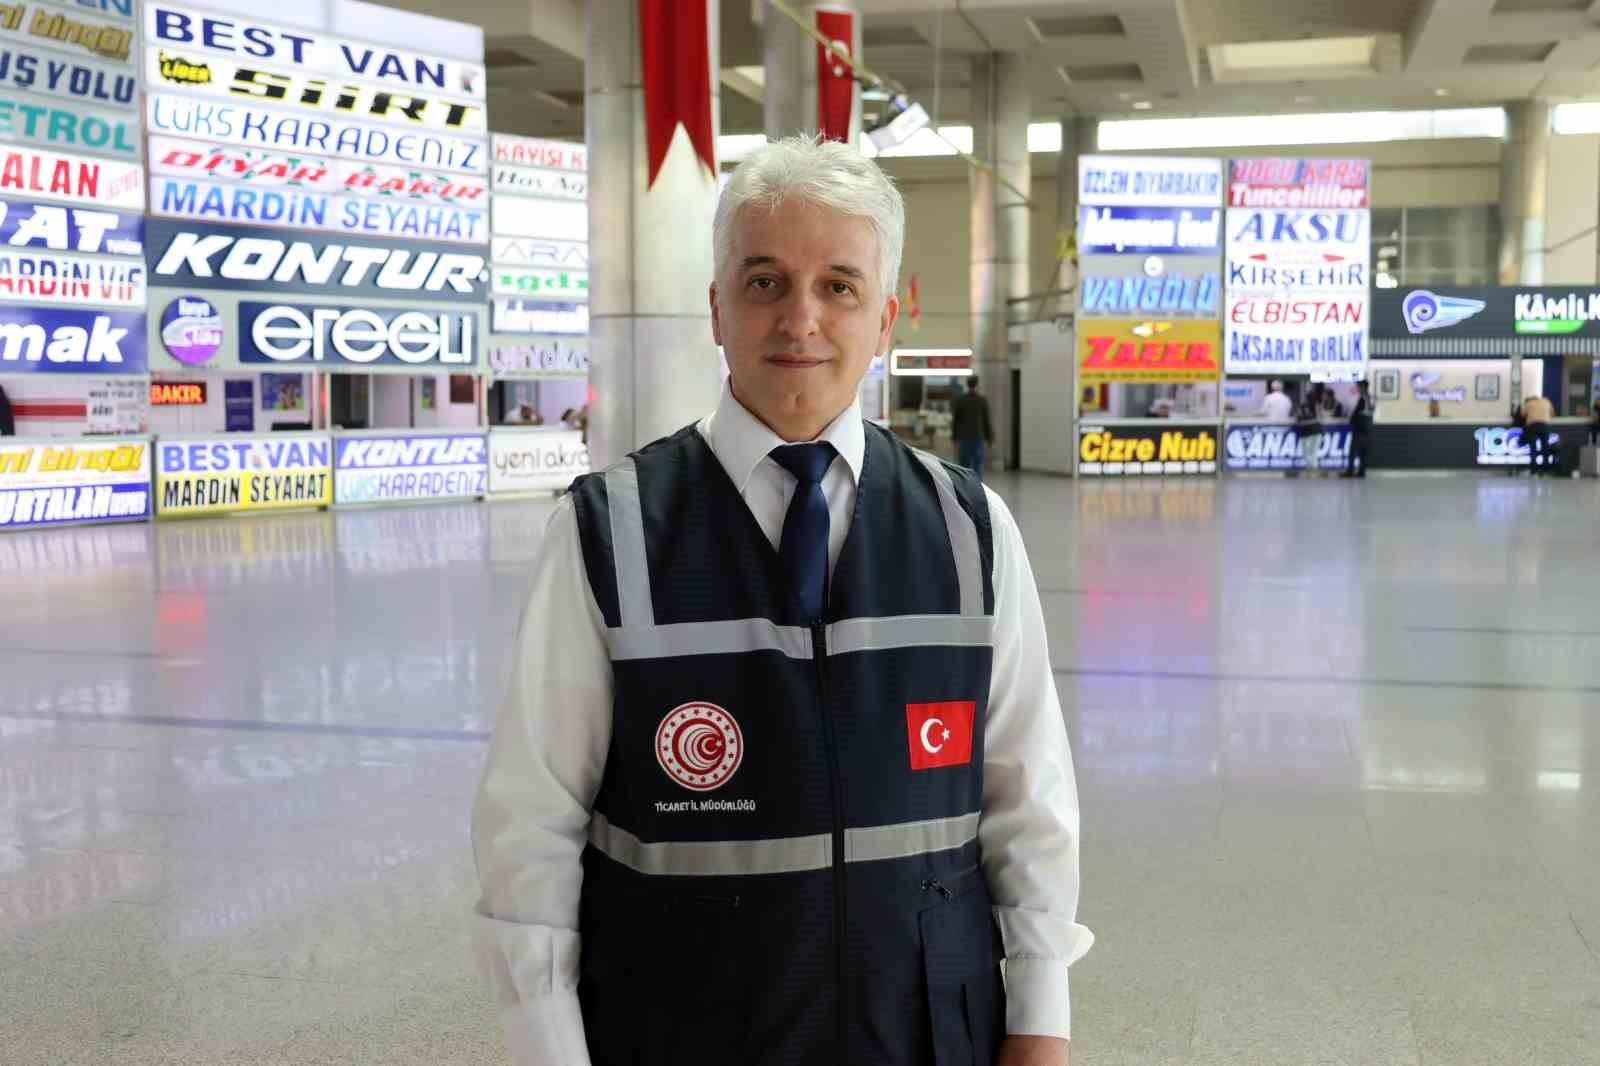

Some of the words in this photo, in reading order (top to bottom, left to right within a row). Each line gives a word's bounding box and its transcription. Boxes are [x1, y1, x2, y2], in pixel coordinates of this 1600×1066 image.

[156, 9, 314, 64] BEST
[341, 45, 445, 88] VAN
[1, 153, 99, 198] ALAN
[342, 200, 480, 239] SEYAHAT
[1232, 212, 1362, 243] AKSU
[155, 232, 485, 293] KONTUR
[1231, 331, 1304, 362] AKSARAY
[163, 443, 253, 473] BEST
[264, 442, 328, 470] VAN
[340, 437, 485, 468] KONTUR
[1081, 431, 1156, 463] Cizre
[1160, 430, 1216, 463] Nuh
[251, 473, 327, 503] SEYAHAT
